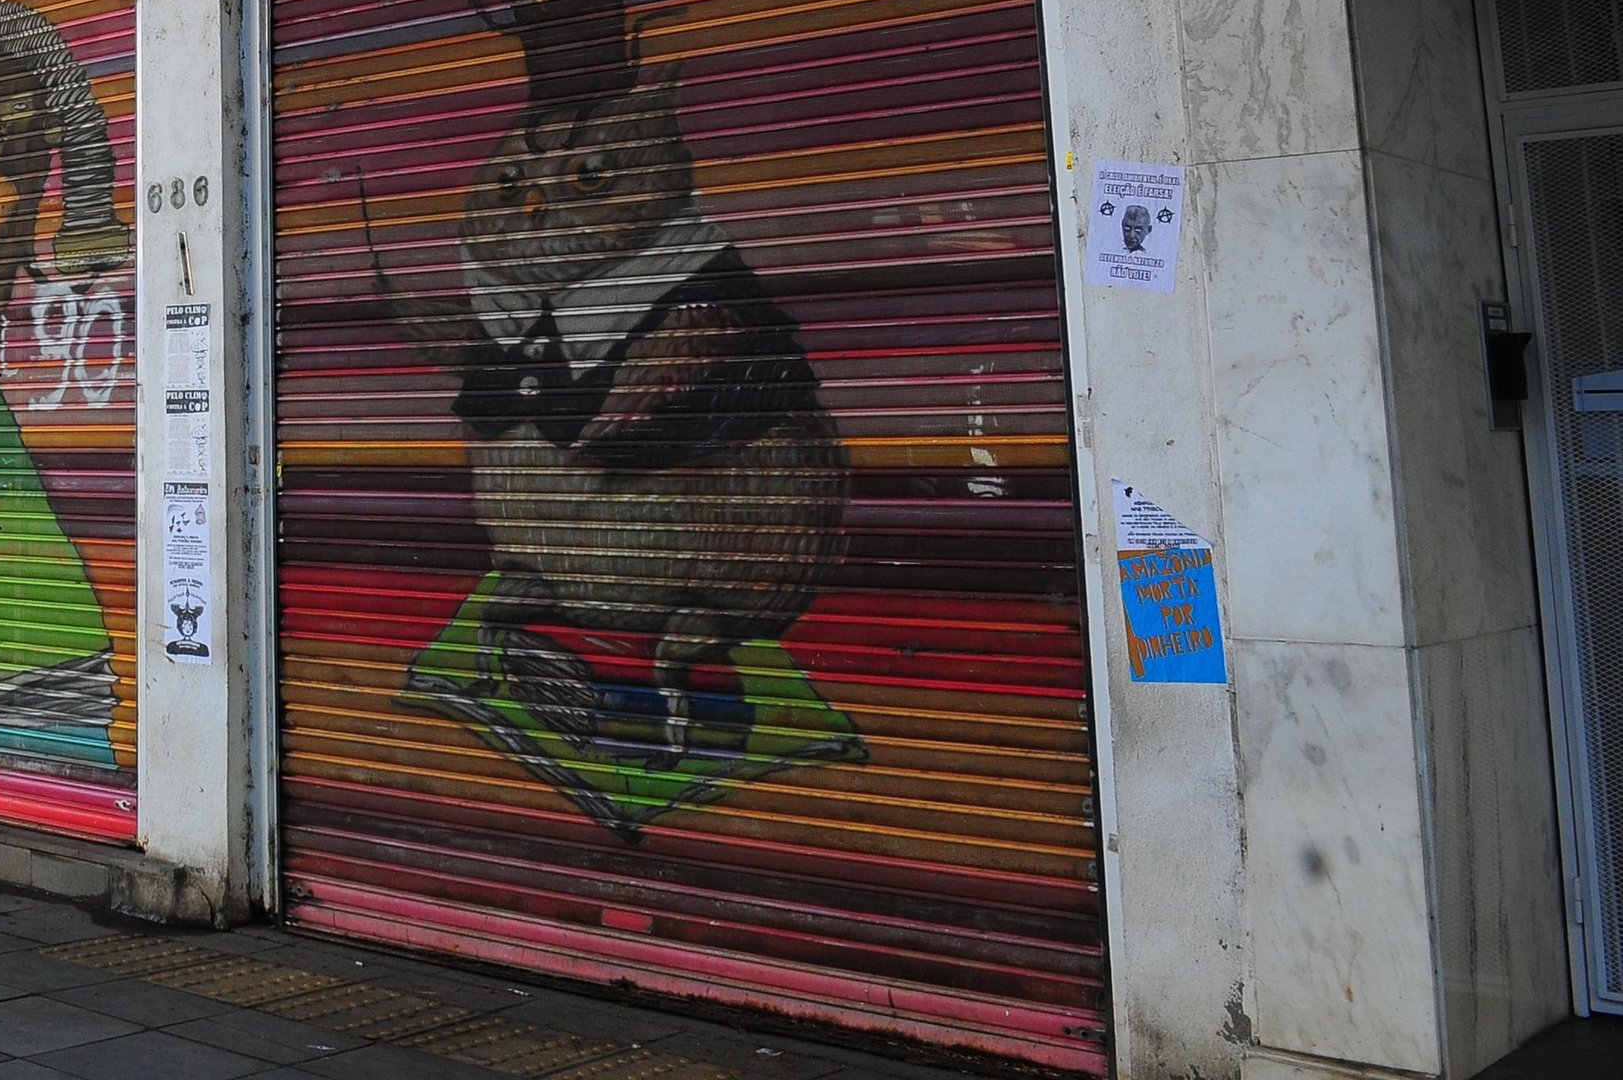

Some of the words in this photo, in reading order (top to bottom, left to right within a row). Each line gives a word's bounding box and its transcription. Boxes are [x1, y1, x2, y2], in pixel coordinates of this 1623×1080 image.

[147, 175, 209, 214] 686
[1104, 183, 1135, 198] ELEIÇÃO
[1144, 187, 1173, 199] FARSA!
[1110, 265, 1127, 278] NÃO
[29, 282, 124, 410] 90
[1136, 575, 1201, 606] MORTA
[1160, 603, 1196, 629] POR
